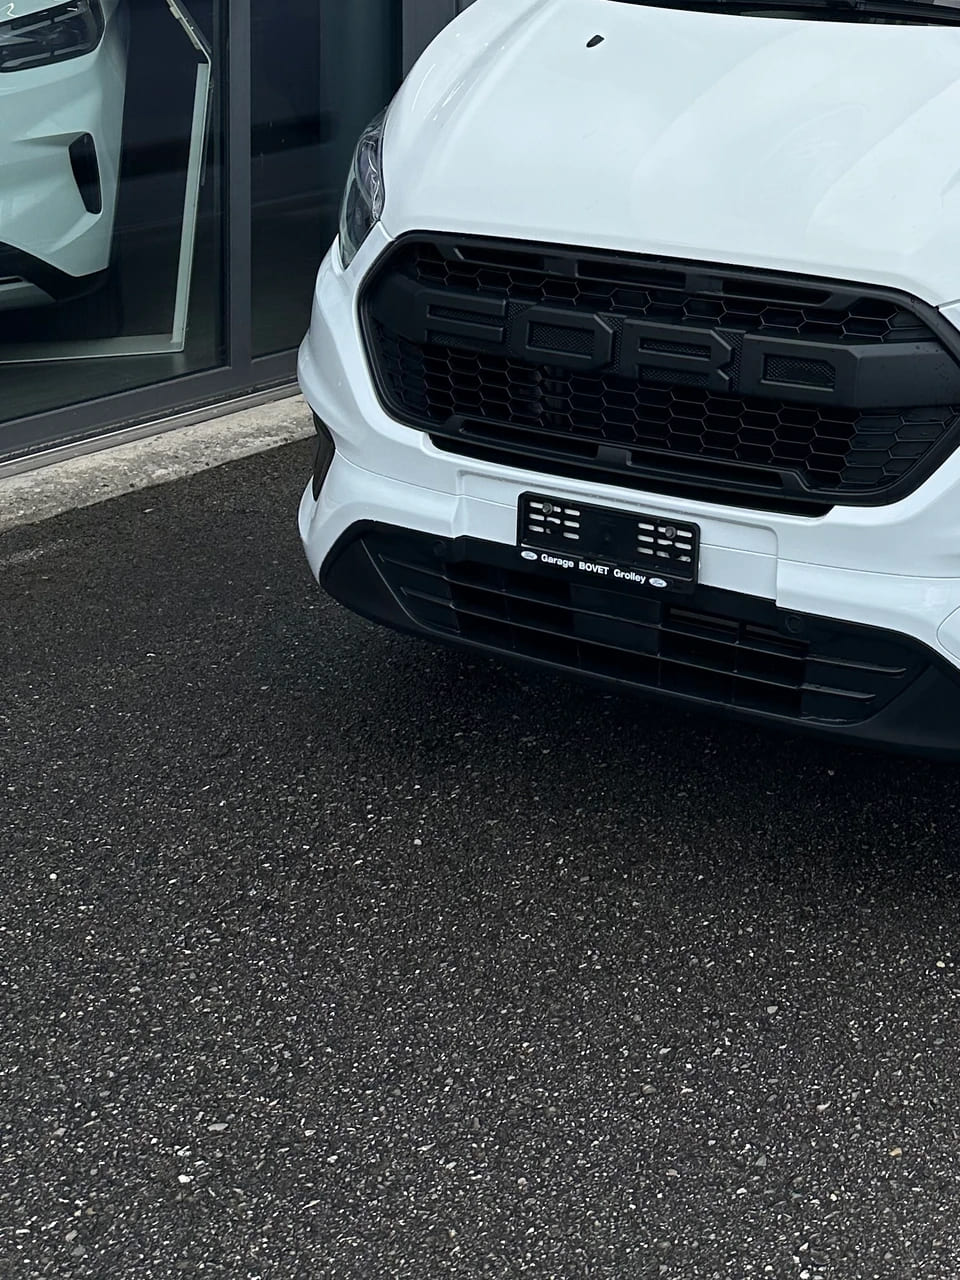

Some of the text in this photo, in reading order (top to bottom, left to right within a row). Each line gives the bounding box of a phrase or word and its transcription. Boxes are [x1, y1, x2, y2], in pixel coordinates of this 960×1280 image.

[412, 288, 858, 408] FORD
[541, 553, 574, 568] Garage
[579, 561, 609, 575] BOVET
[613, 568, 646, 584] Grolley
